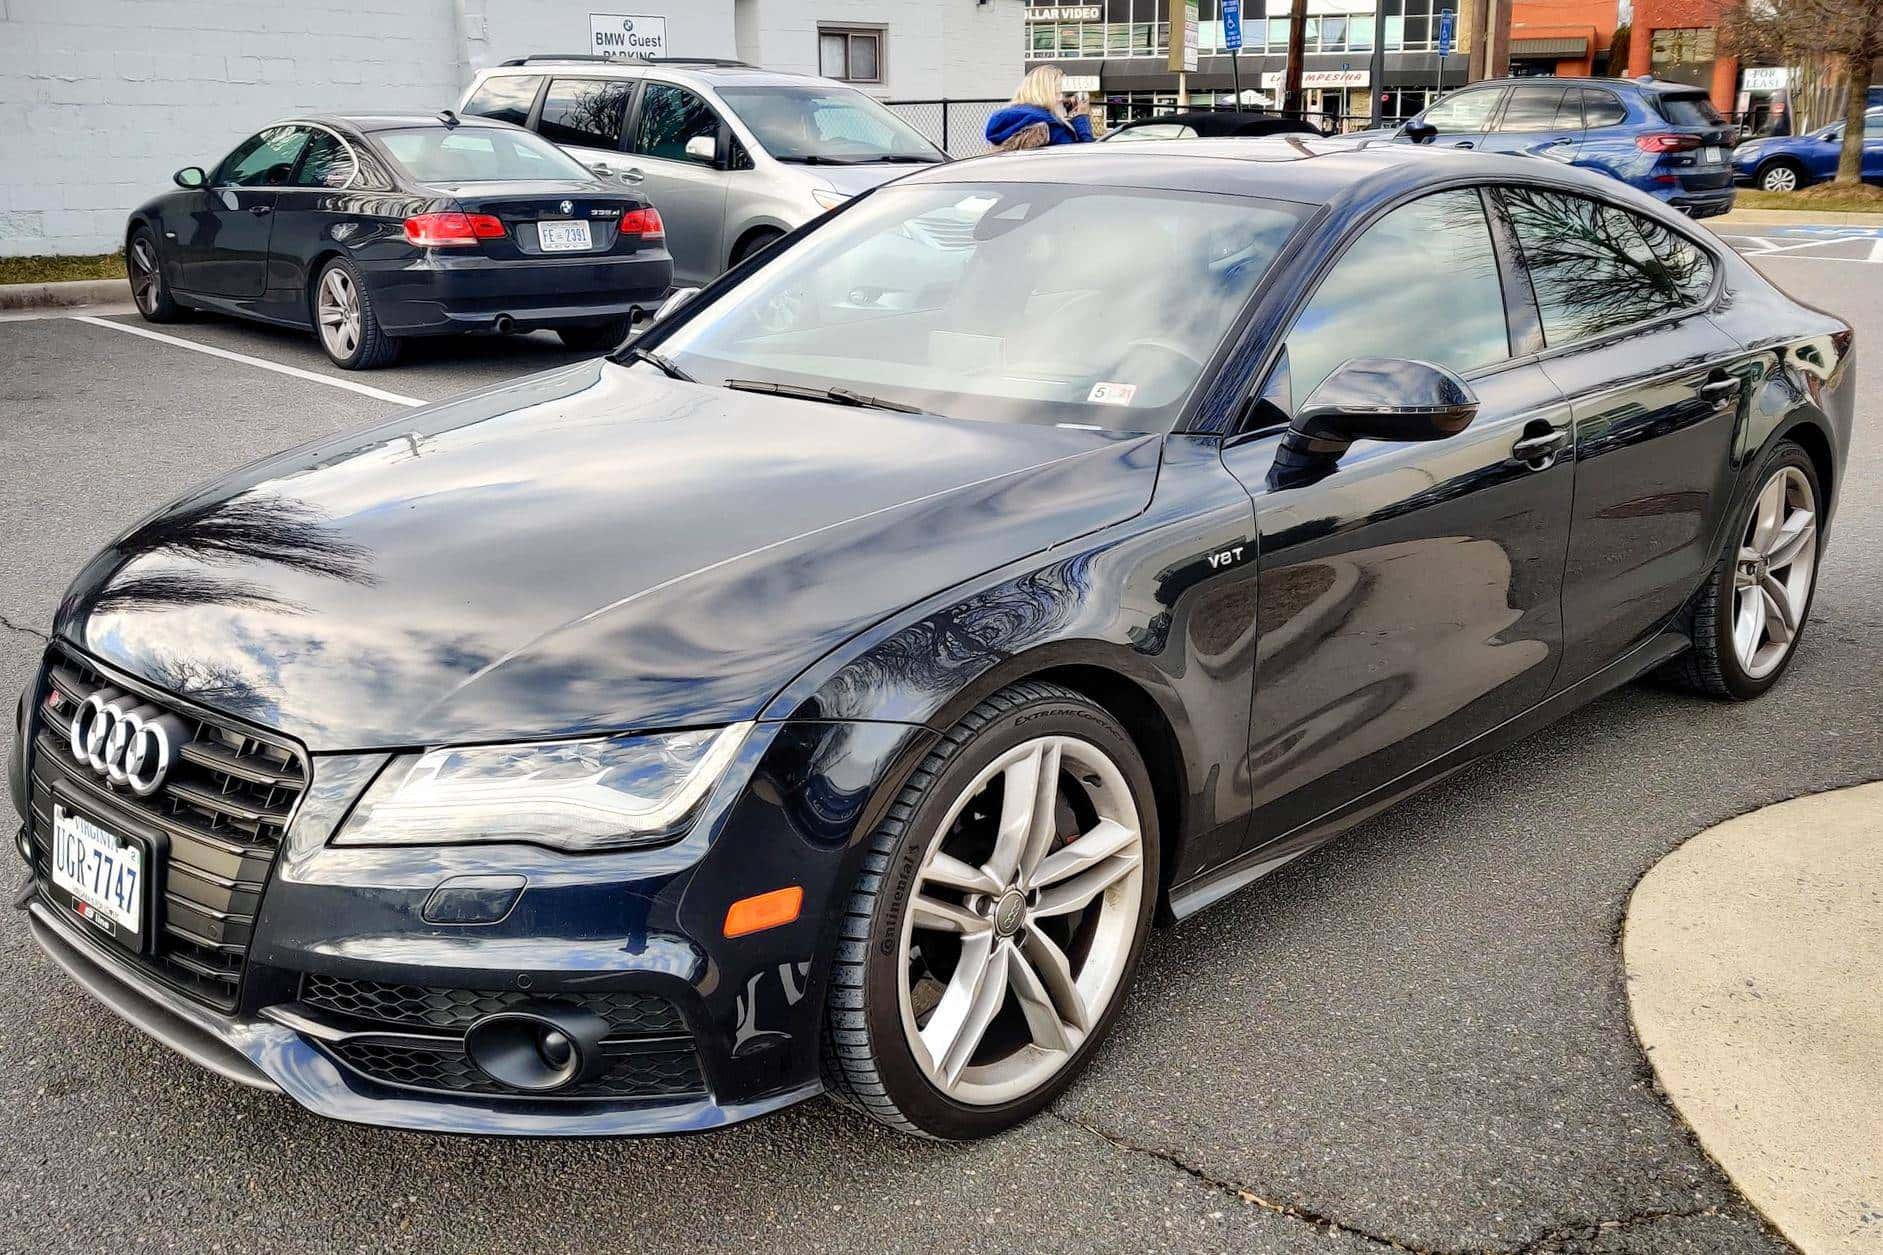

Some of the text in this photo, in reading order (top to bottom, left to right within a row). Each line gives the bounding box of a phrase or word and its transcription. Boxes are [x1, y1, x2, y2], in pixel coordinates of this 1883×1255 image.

[1062, 7, 1099, 19] VIDEO
[595, 32, 662, 48] BMW Guest
[1751, 69, 1777, 79] FOR
[1094, 386, 1107, 399] 5
[1207, 546, 1244, 569] V8T
[56, 825, 137, 914] UGR-7747
